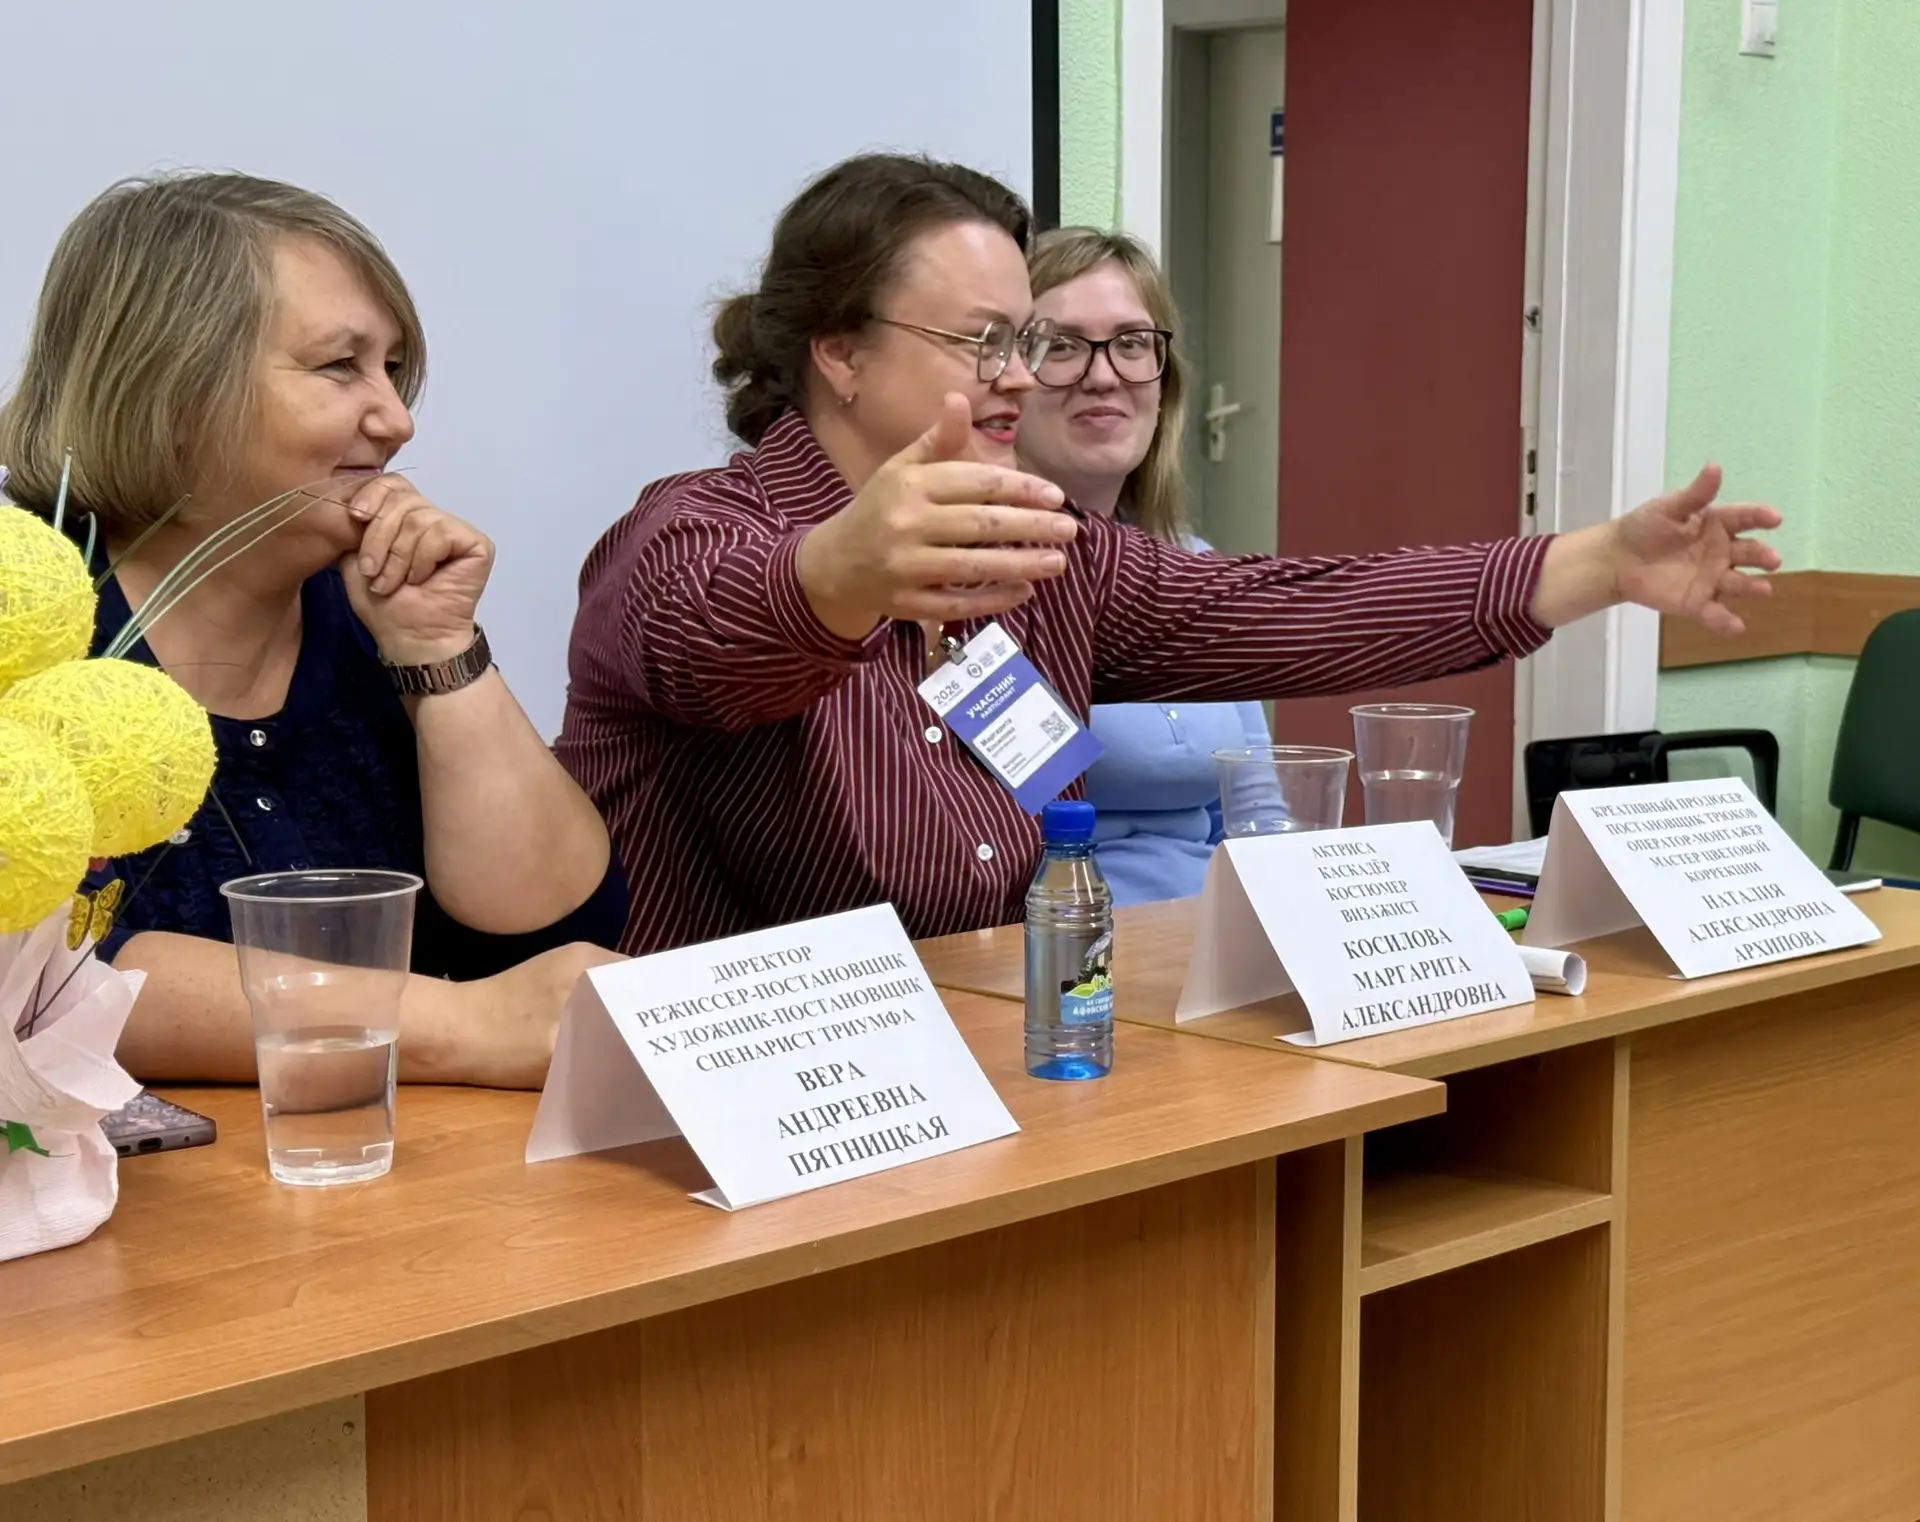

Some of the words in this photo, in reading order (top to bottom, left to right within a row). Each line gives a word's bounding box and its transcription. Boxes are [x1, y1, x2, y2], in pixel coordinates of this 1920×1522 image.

[933, 680, 960, 705] 2026
[966, 672, 1017, 719] УЧАСТНИК
[981, 686, 1017, 720] PARTICIPANT
[1590, 798, 1677, 818] КРЕАТИВНЫЙ
[1676, 792, 1744, 811] ПРОДЮСЕР
[1605, 813, 1705, 836] ПОСТАНОВЩИК
[1704, 807, 1758, 825] ТРЮКОВ
[1312, 842, 1377, 859] АКТРИСА
[1626, 824, 1765, 852] ОПЕРАТОР-МОНТАЖЕР
[1649, 851, 1702, 869] МАСТЕР
[1703, 840, 1771, 864] ЦВЕТОВОЙ
[1317, 859, 1391, 880] КАСКАДЁР
[1684, 862, 1763, 883] КОРРЕКЦИИ
[1326, 880, 1408, 902] КОСТЮМЕР
[1701, 883, 1786, 910] НАТАЛИЯ
[1340, 900, 1419, 923] ВИЗАЖИСТ
[1687, 900, 1836, 943] АЛЕКСАНДРОВНА
[1342, 927, 1453, 960] КОСИЛОВА
[1733, 929, 1827, 963] АРХИПОВА
[709, 945, 813, 984] ДИРЕКТОР
[1352, 954, 1472, 991] МАРГАРИТА
[636, 952, 907, 1028] РЕЖИССЕР-ПОСТАНОВЩИК
[1341, 981, 1507, 1030] АЛЕКСАНДРОВНА
[647, 976, 925, 1056] ХУДОЖНИК-ПОСТАНОВЩИК
[695, 1030, 818, 1073] СЦЕНАРИСТ
[817, 1007, 917, 1047] ТРИУМФА
[795, 1060, 866, 1092] ВЕРА
[777, 1082, 928, 1139] АНДРЕЕВНА
[788, 1115, 951, 1177] ПЯТНИЦКАЯ
